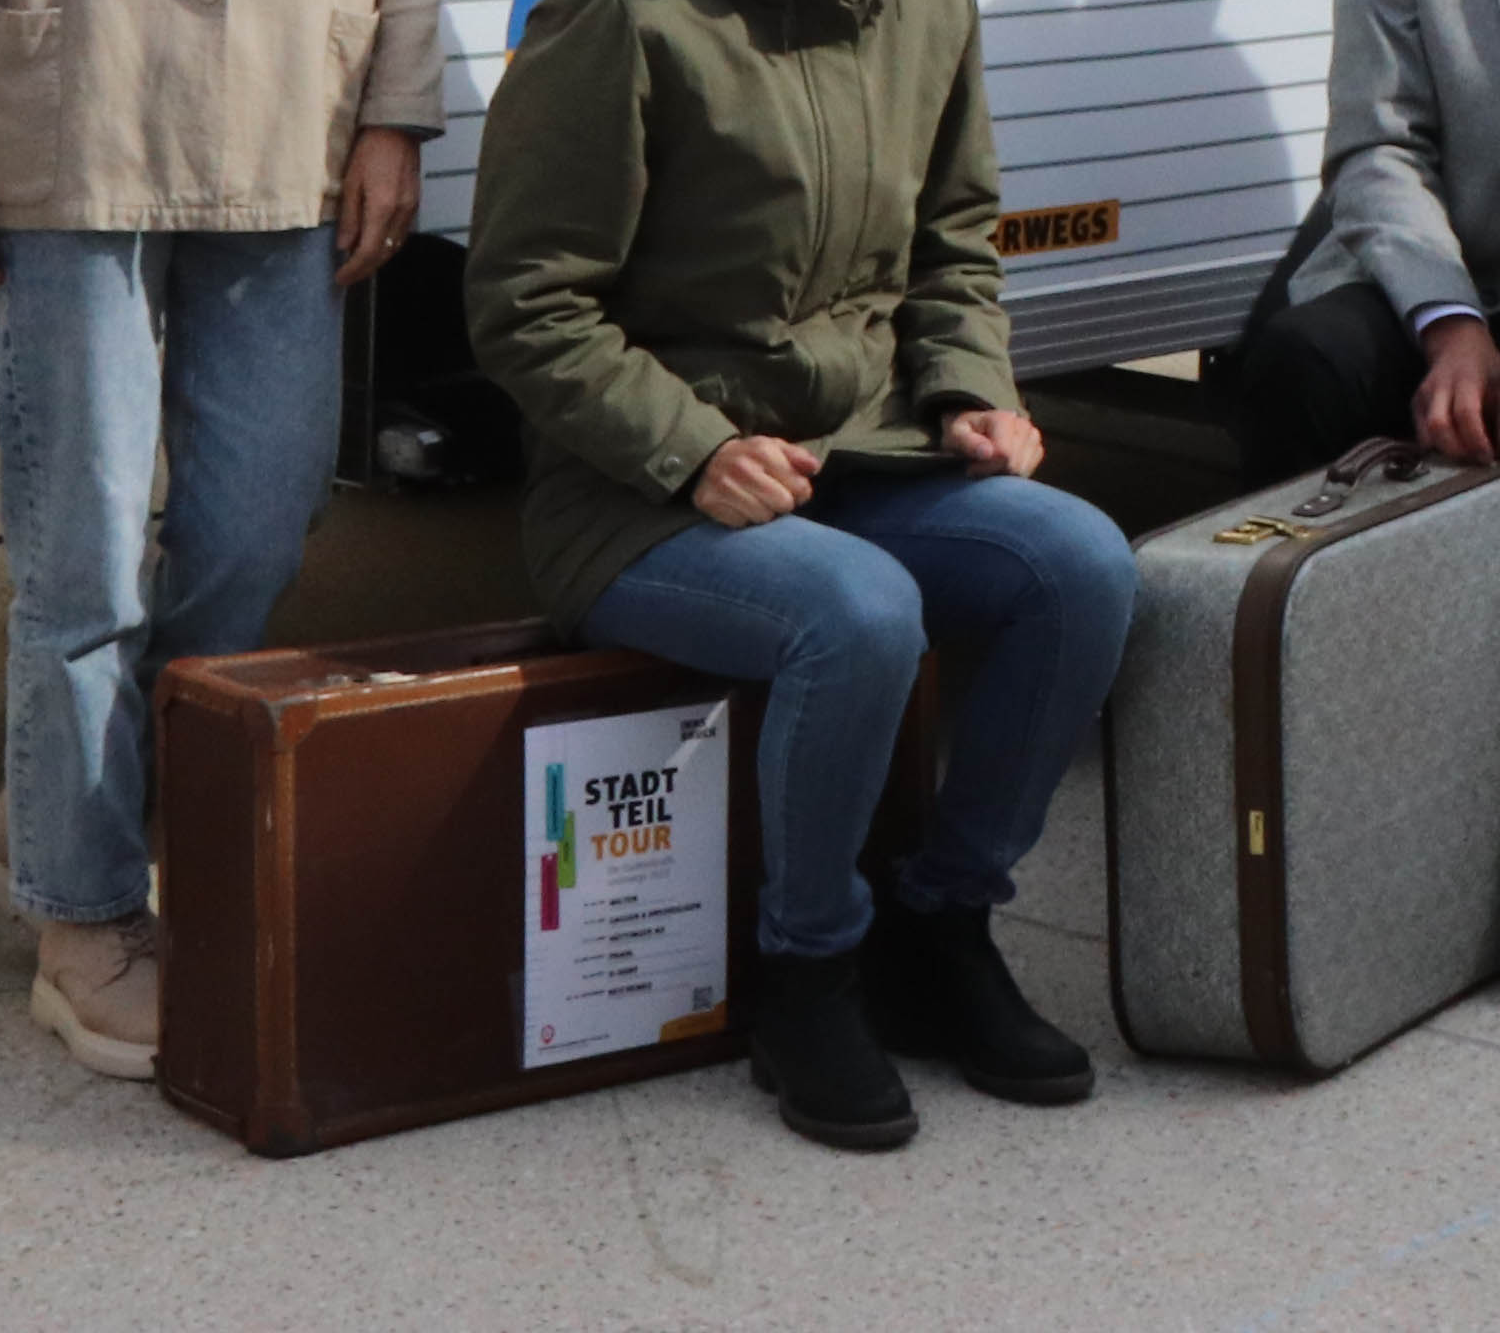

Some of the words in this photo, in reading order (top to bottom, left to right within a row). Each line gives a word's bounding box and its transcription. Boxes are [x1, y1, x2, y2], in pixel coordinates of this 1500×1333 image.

[988, 206, 1109, 252] RWEGS
[583, 766, 679, 806] STADT
[608, 798, 673, 829] TEIL
[590, 825, 672, 861] TOUR
